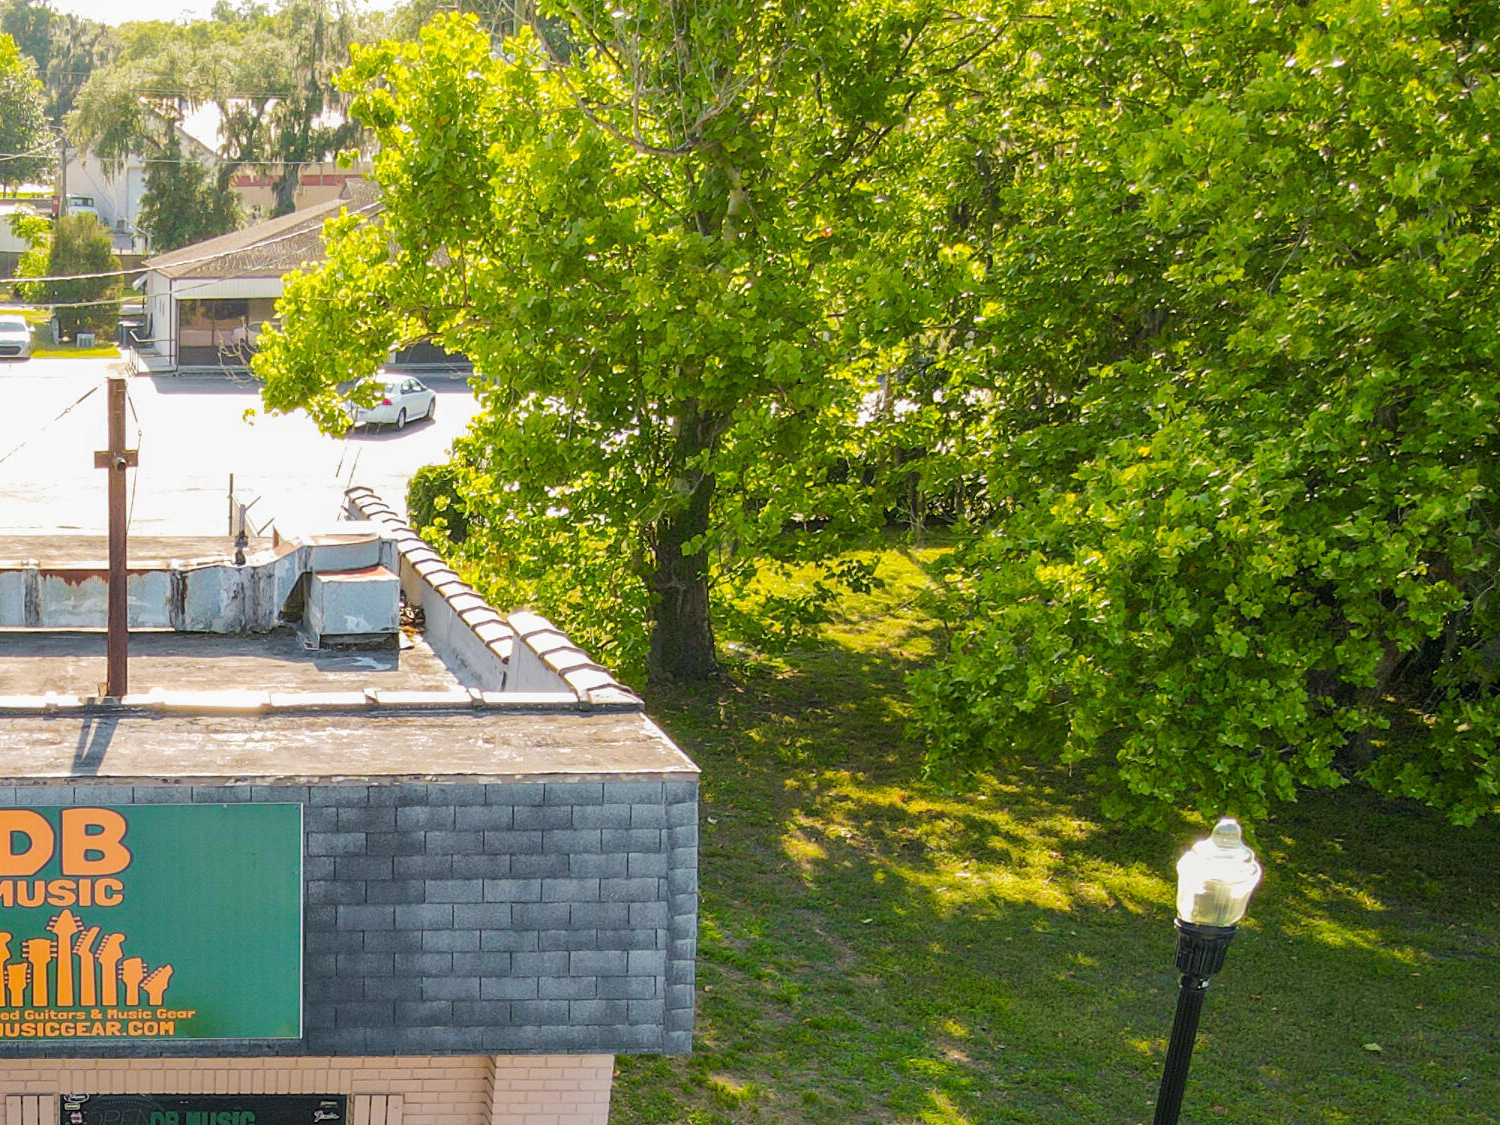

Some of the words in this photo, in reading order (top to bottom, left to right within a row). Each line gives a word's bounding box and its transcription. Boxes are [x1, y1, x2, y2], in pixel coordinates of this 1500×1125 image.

[24, 1009, 86, 1020] Guitars
[90, 1009, 102, 1020] &
[107, 1008, 151, 1020] Music
[156, 1008, 196, 1019] Gear
